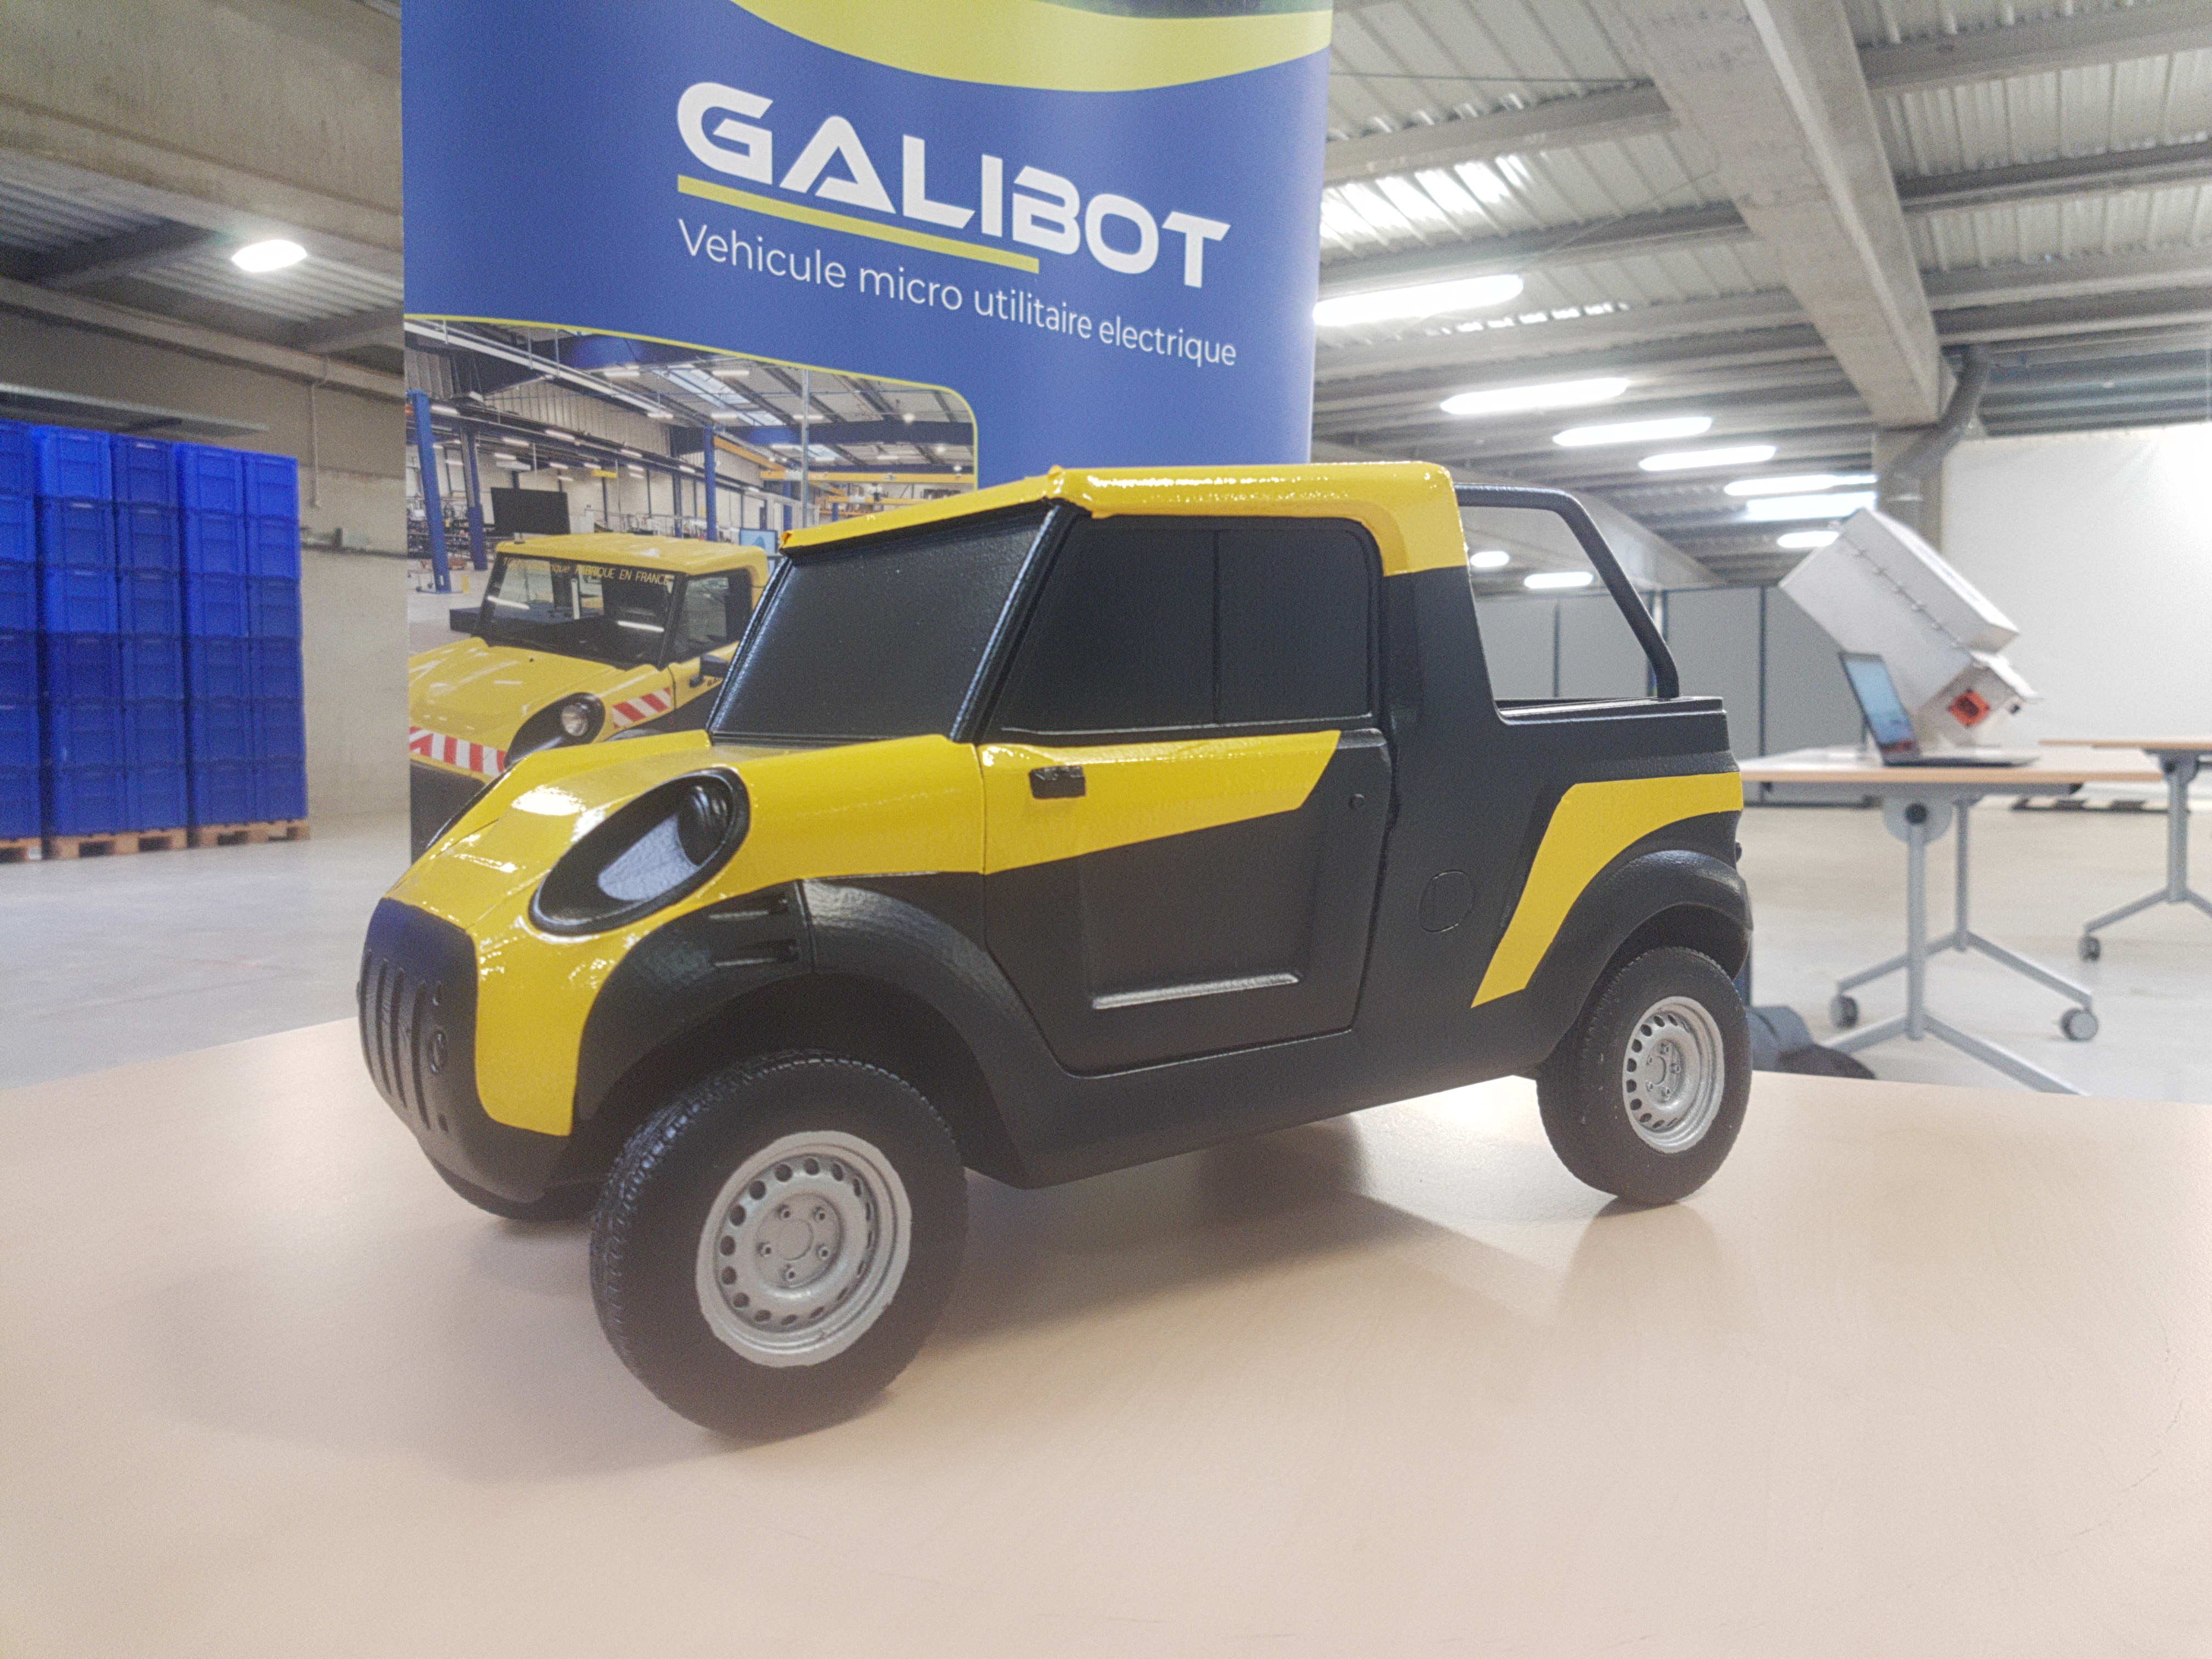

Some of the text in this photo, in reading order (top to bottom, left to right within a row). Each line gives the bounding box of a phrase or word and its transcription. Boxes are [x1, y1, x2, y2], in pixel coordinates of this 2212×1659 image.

[678, 82, 1231, 287] GALIBOT
[679, 218, 1237, 367] Vehicule micro utilitaire electrique
[619, 569, 633, 580] EN
[635, 571, 669, 586] FRANCE
